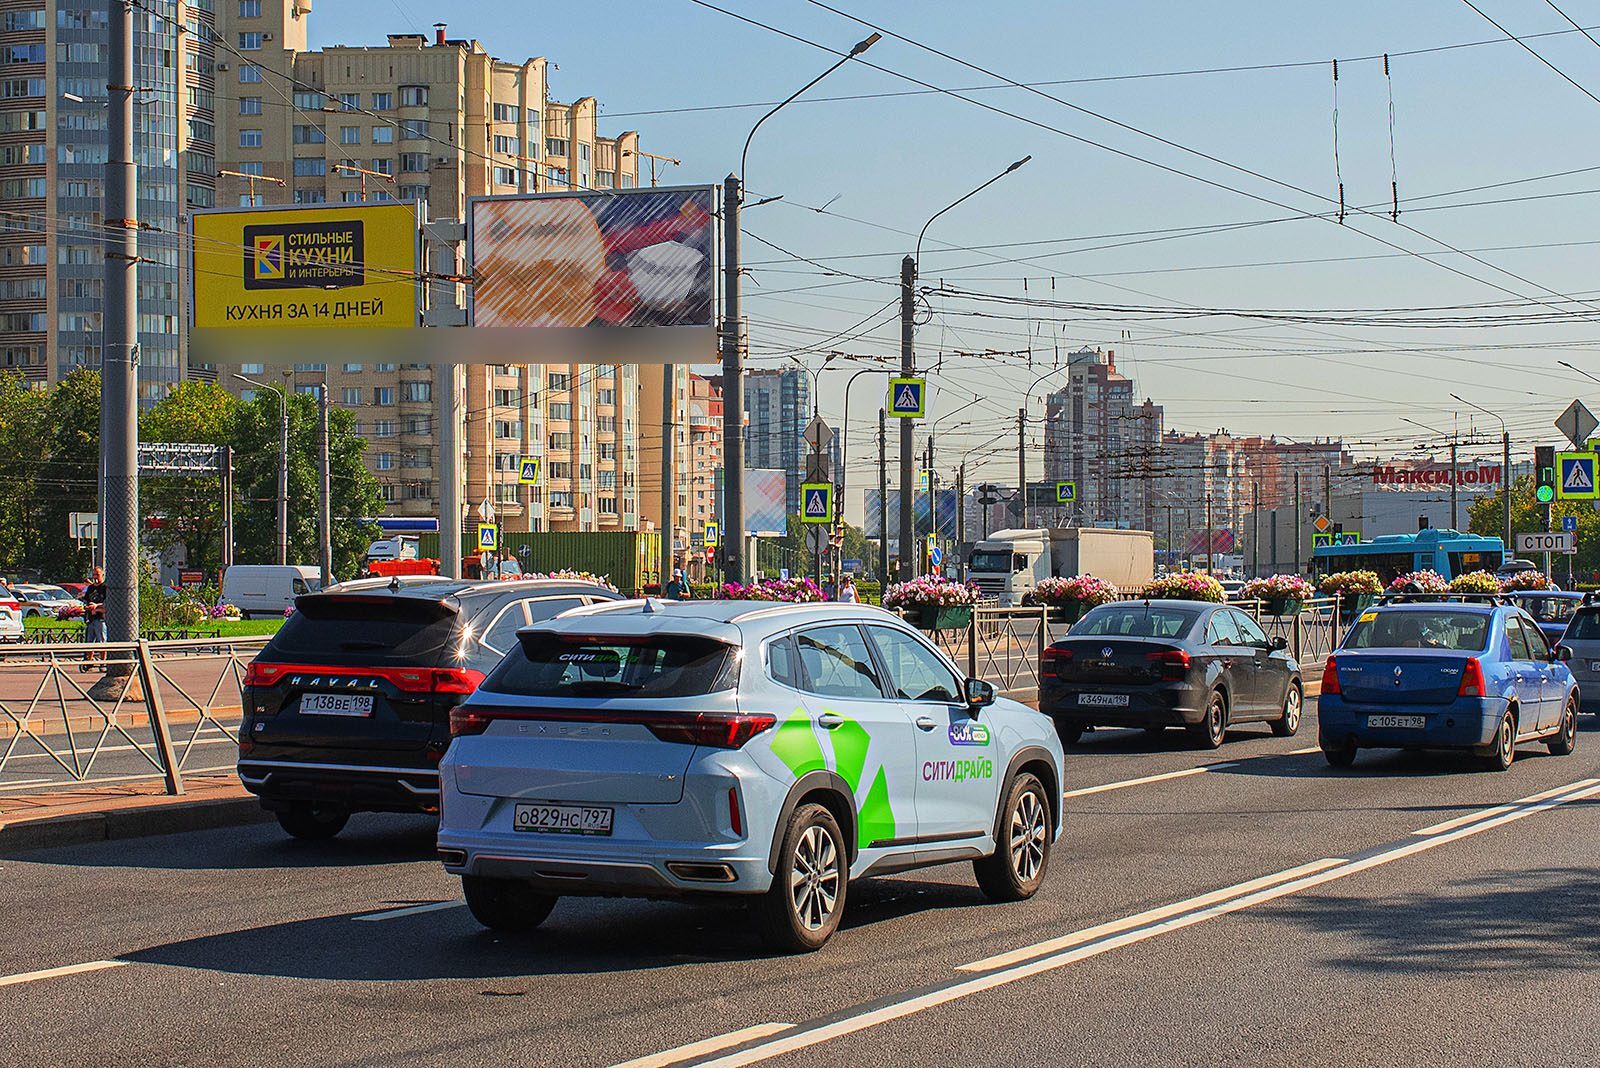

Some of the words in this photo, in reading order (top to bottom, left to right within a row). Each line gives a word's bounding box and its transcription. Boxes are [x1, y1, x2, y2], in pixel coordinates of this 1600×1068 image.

[288, 231, 353, 246] СТИЛЬНЫЕ
[289, 246, 354, 267] КУХНИ
[289, 269, 297, 279] И
[299, 267, 355, 279] ИНТЕРЬЕРЫ
[226, 304, 282, 320] КУХНЯ
[287, 303, 309, 319] ЗА
[313, 302, 329, 318] 14
[333, 298, 383, 319] ДНЕЙ
[1524, 536, 1564, 549] СТОП
[291, 676, 378, 688] HAVAL
[922, 755, 992, 783] СИТИДРАЙВ
[583, 810, 608, 825] 797
